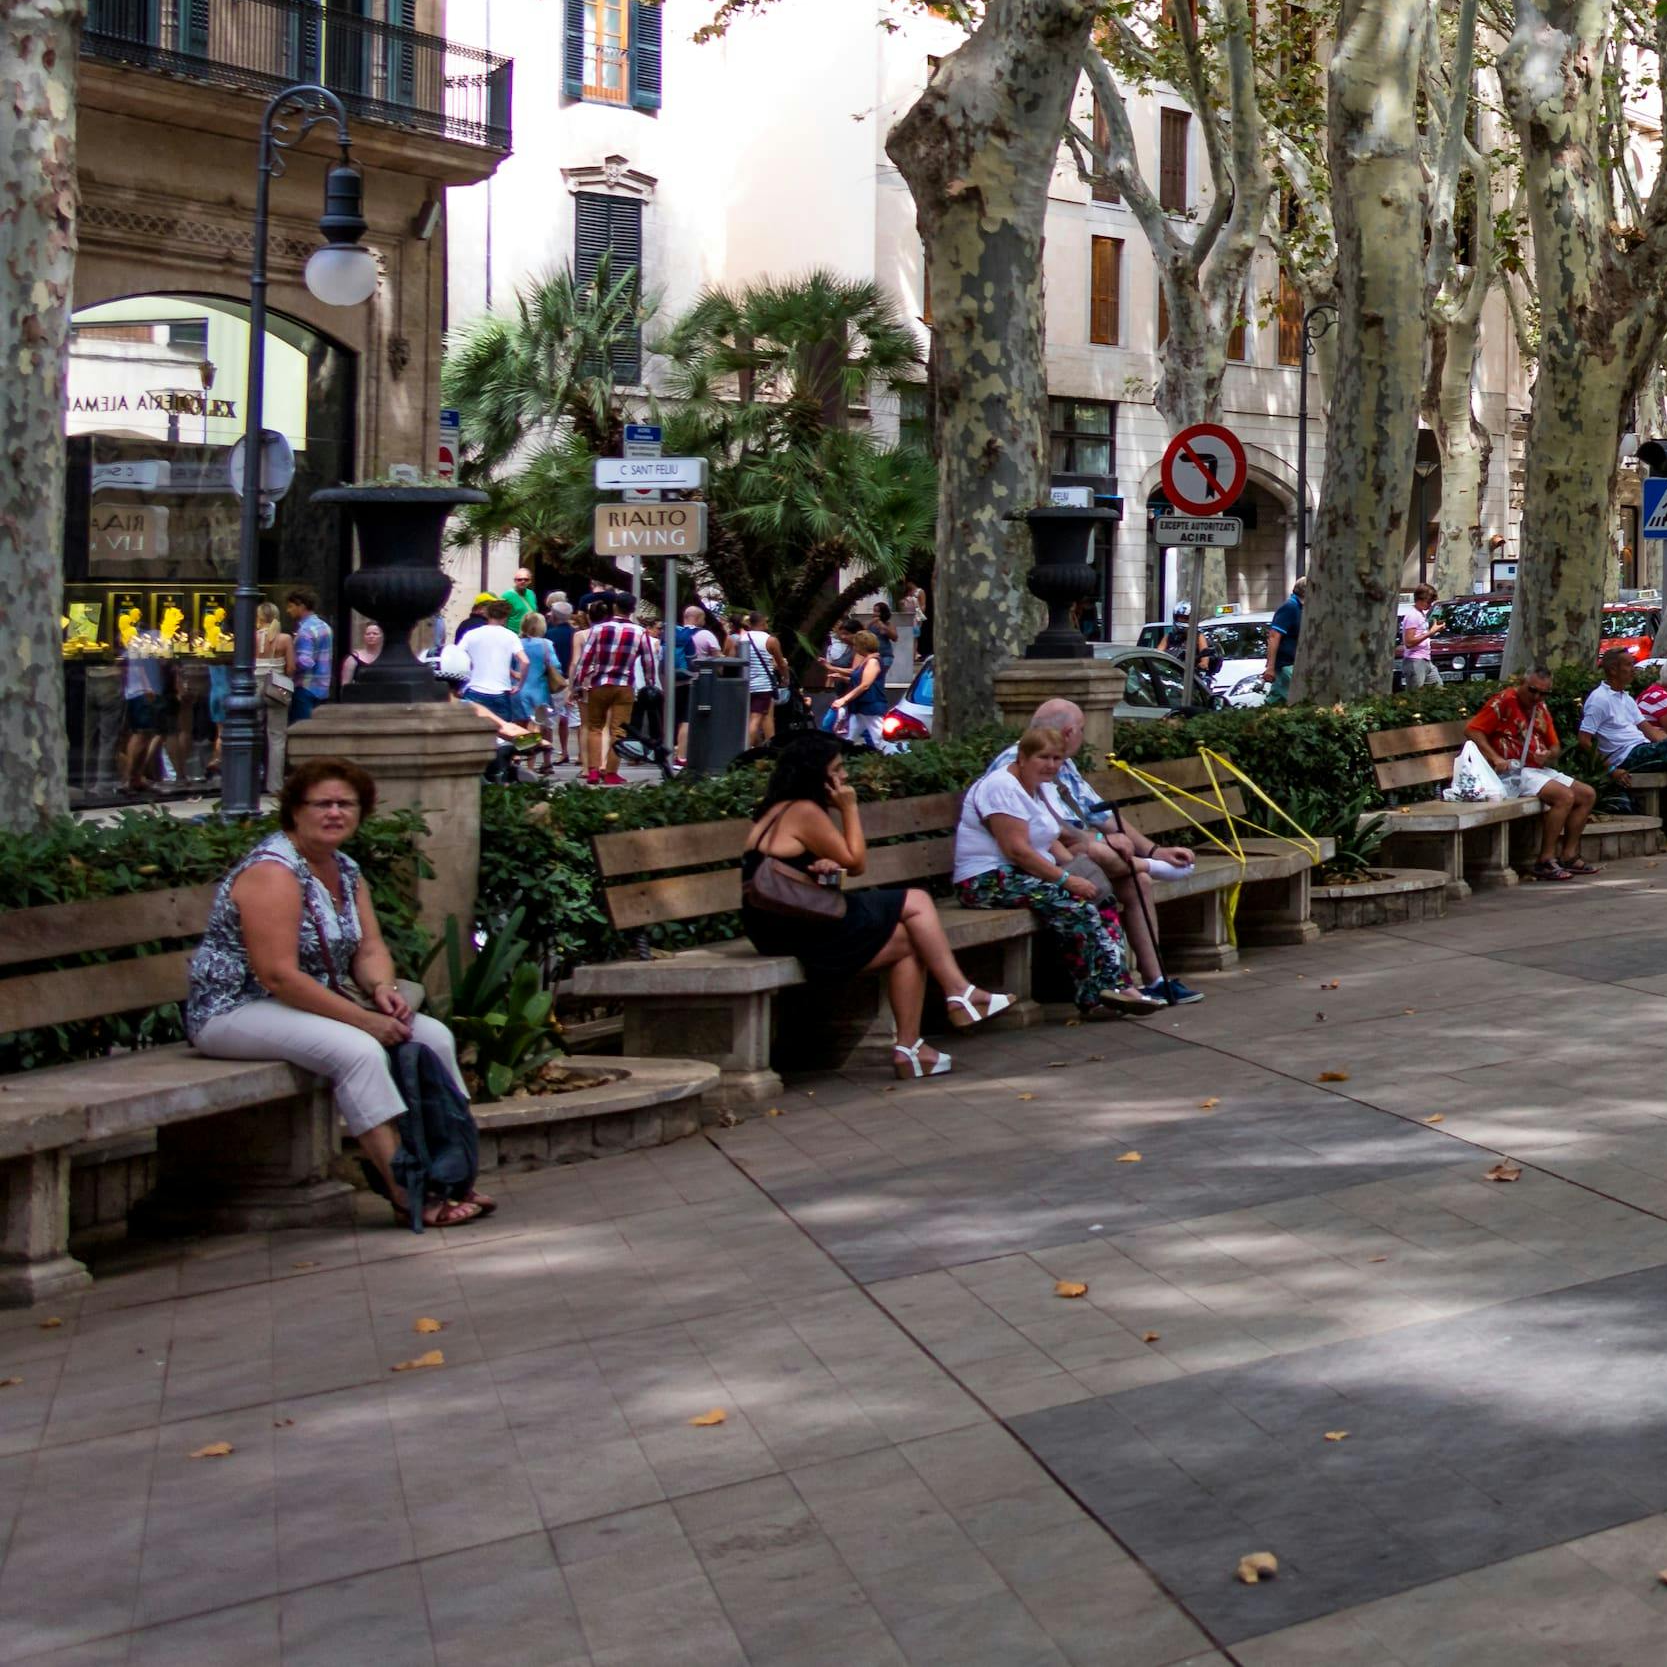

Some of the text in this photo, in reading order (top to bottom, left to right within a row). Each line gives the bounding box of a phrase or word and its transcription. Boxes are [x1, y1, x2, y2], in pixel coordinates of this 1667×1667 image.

[620, 464, 679, 476] C SANT FELIU
[608, 510, 687, 527] RIALTO
[1160, 521, 1236, 532] EXCEPTE AUTORITZATS
[608, 529, 686, 548] LIVING
[1180, 533, 1215, 543] ACIRE
